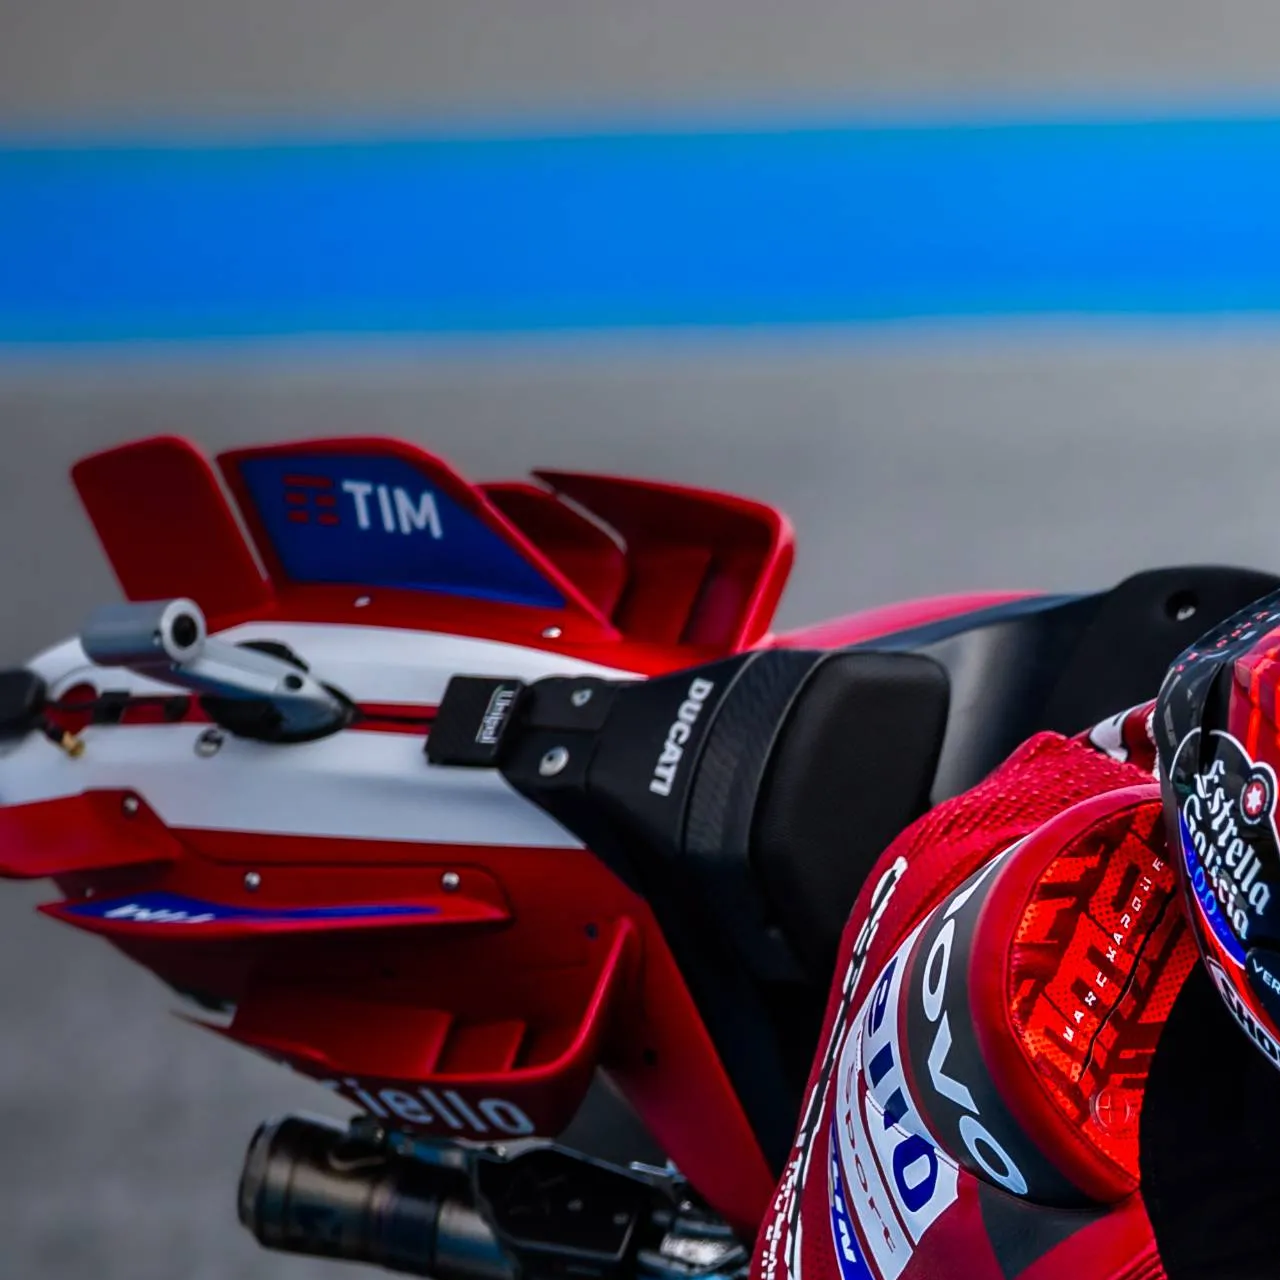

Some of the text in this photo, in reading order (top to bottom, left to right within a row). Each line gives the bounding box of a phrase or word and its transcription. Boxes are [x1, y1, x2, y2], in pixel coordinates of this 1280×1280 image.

[343, 480, 443, 539] TIM
[650, 677, 714, 797] DUCATI
[1194, 759, 1271, 916] Estrella
